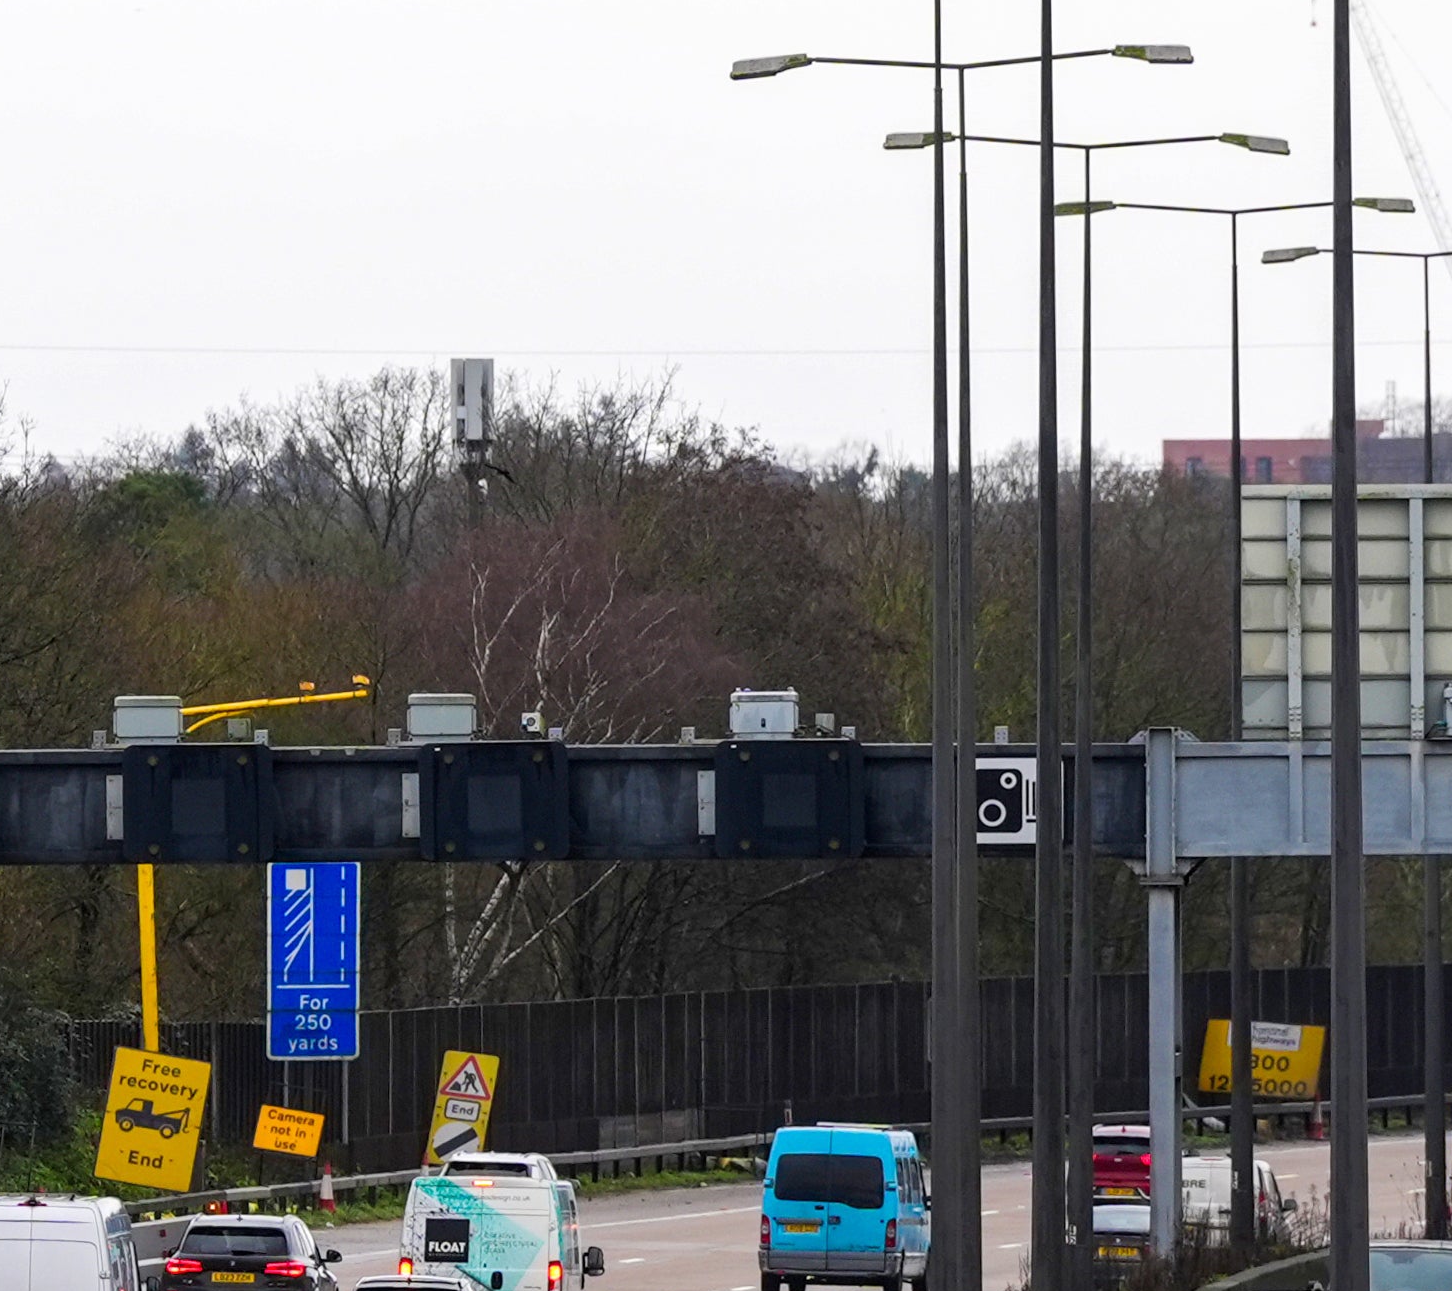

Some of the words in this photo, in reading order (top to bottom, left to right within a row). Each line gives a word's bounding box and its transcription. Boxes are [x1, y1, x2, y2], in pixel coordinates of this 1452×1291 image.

[299, 994, 329, 1011] For
[294, 1014, 332, 1031] 250
[288, 1035, 339, 1054] yards
[141, 1058, 182, 1079] Free
[118, 1072, 198, 1102] recovery
[267, 1109, 316, 1127] Camera
[450, 1103, 475, 1118] End
[270, 1123, 292, 1138] not
[295, 1125, 307, 1139] in
[274, 1137, 297, 1152] use
[126, 1149, 164, 1170] End
[428, 1240, 466, 1253] FLOAT
